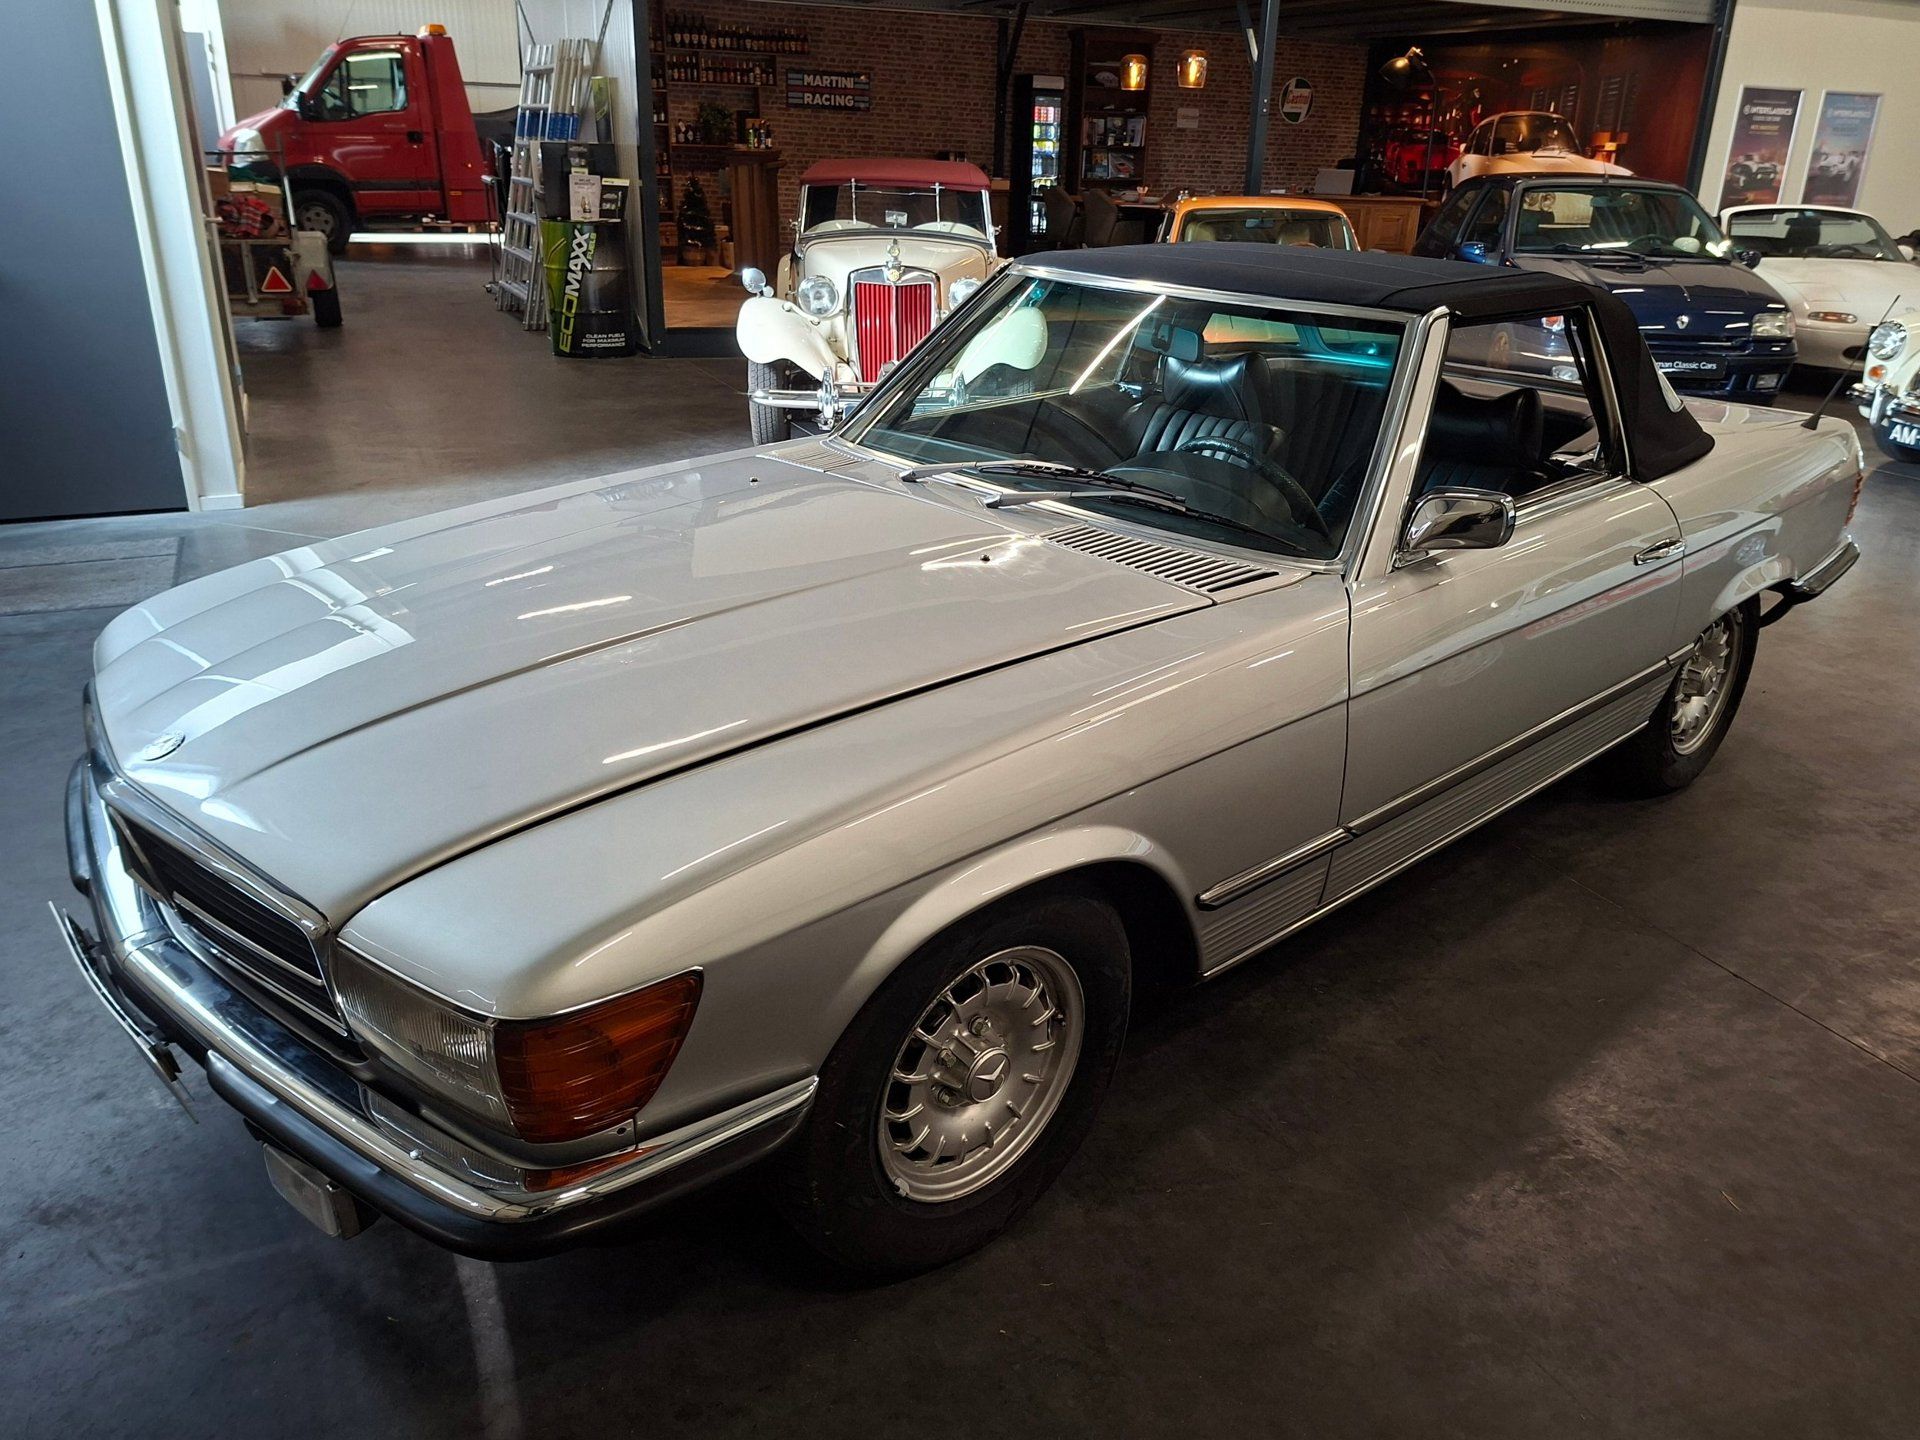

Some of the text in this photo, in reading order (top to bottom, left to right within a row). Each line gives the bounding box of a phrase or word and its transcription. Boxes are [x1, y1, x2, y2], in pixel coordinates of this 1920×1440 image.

[803, 74, 854, 88] MARTINI
[804, 93, 854, 107] RACING
[587, 232, 597, 260] FUELS
[559, 228, 592, 353] ECOMAXX
[1673, 361, 1699, 369] Classic
